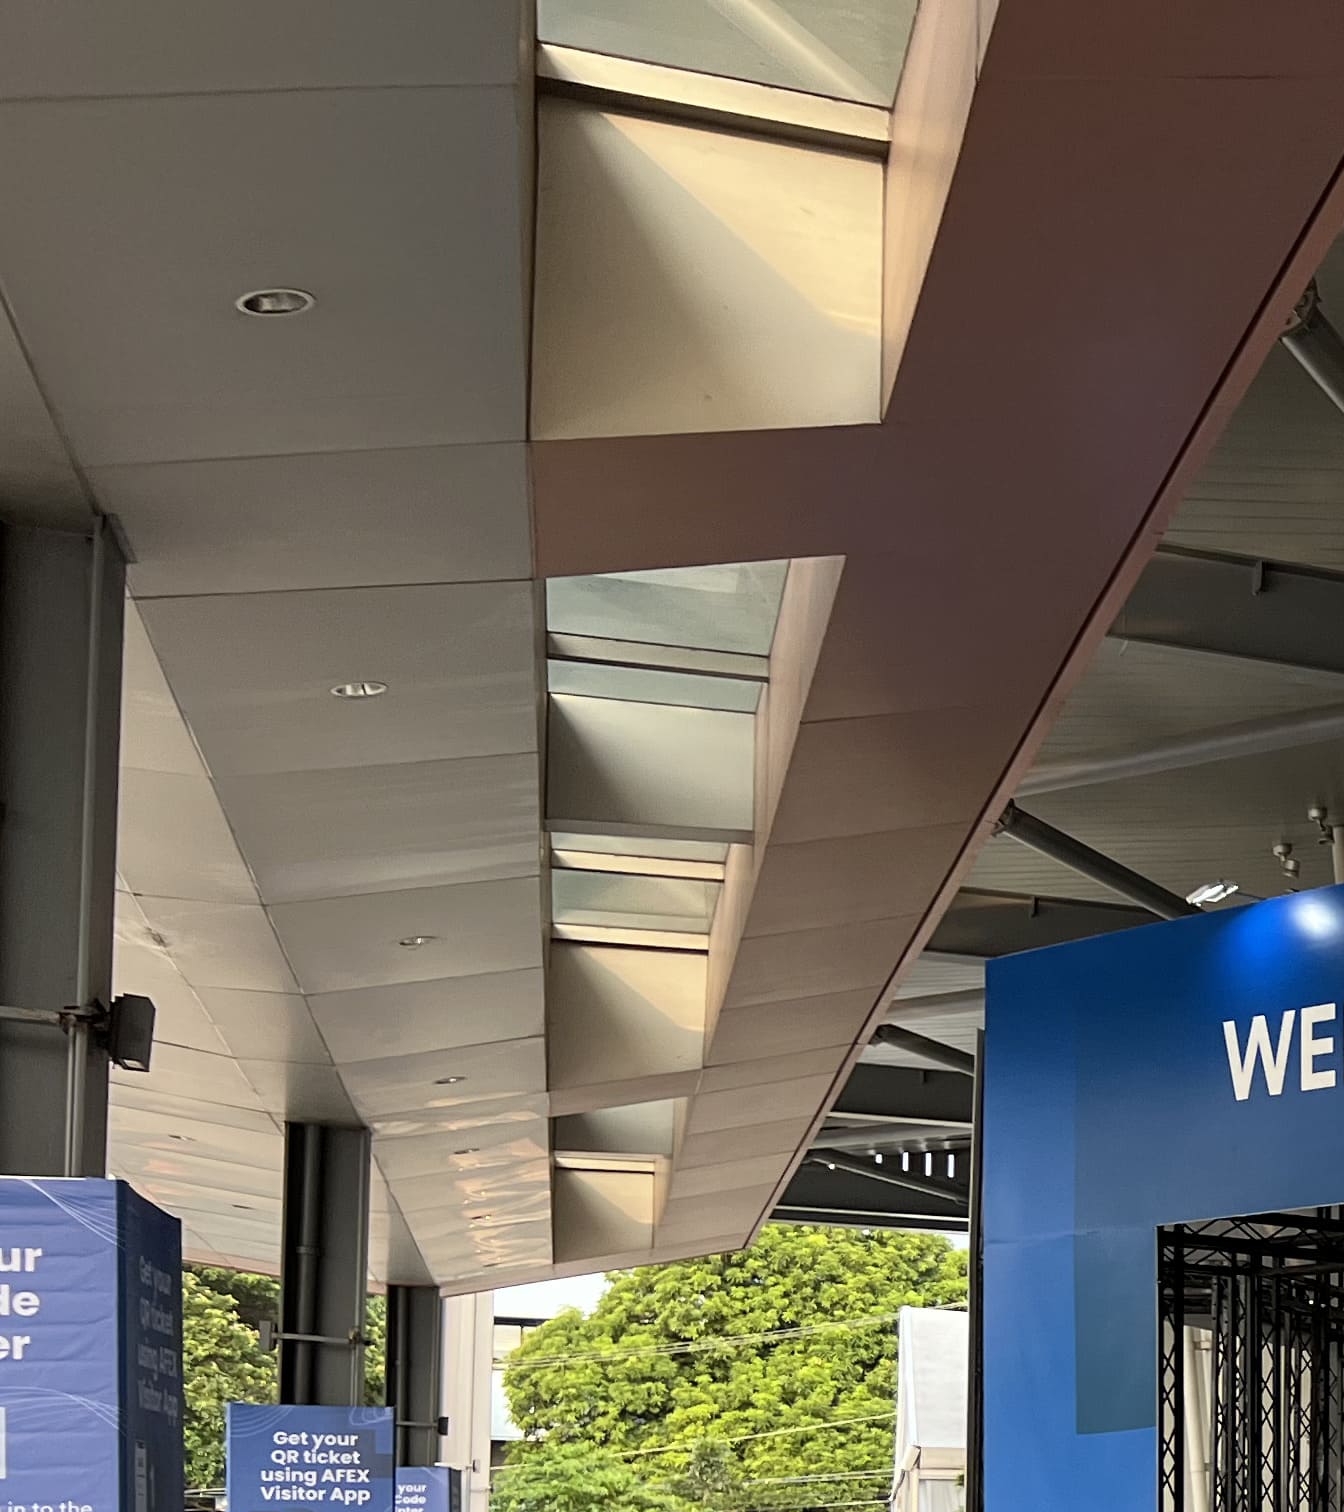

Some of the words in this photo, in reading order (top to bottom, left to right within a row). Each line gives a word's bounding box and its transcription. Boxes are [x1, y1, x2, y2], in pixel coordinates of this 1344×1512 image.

[273, 1431, 308, 1445] Get
[311, 1434, 358, 1451] your
[270, 1450, 299, 1465] QR
[303, 1450, 360, 1464] ticket
[260, 1467, 317, 1486] using
[321, 1469, 369, 1483] AFEX
[260, 1486, 326, 1500] Visitor
[330, 1487, 371, 1505] App
